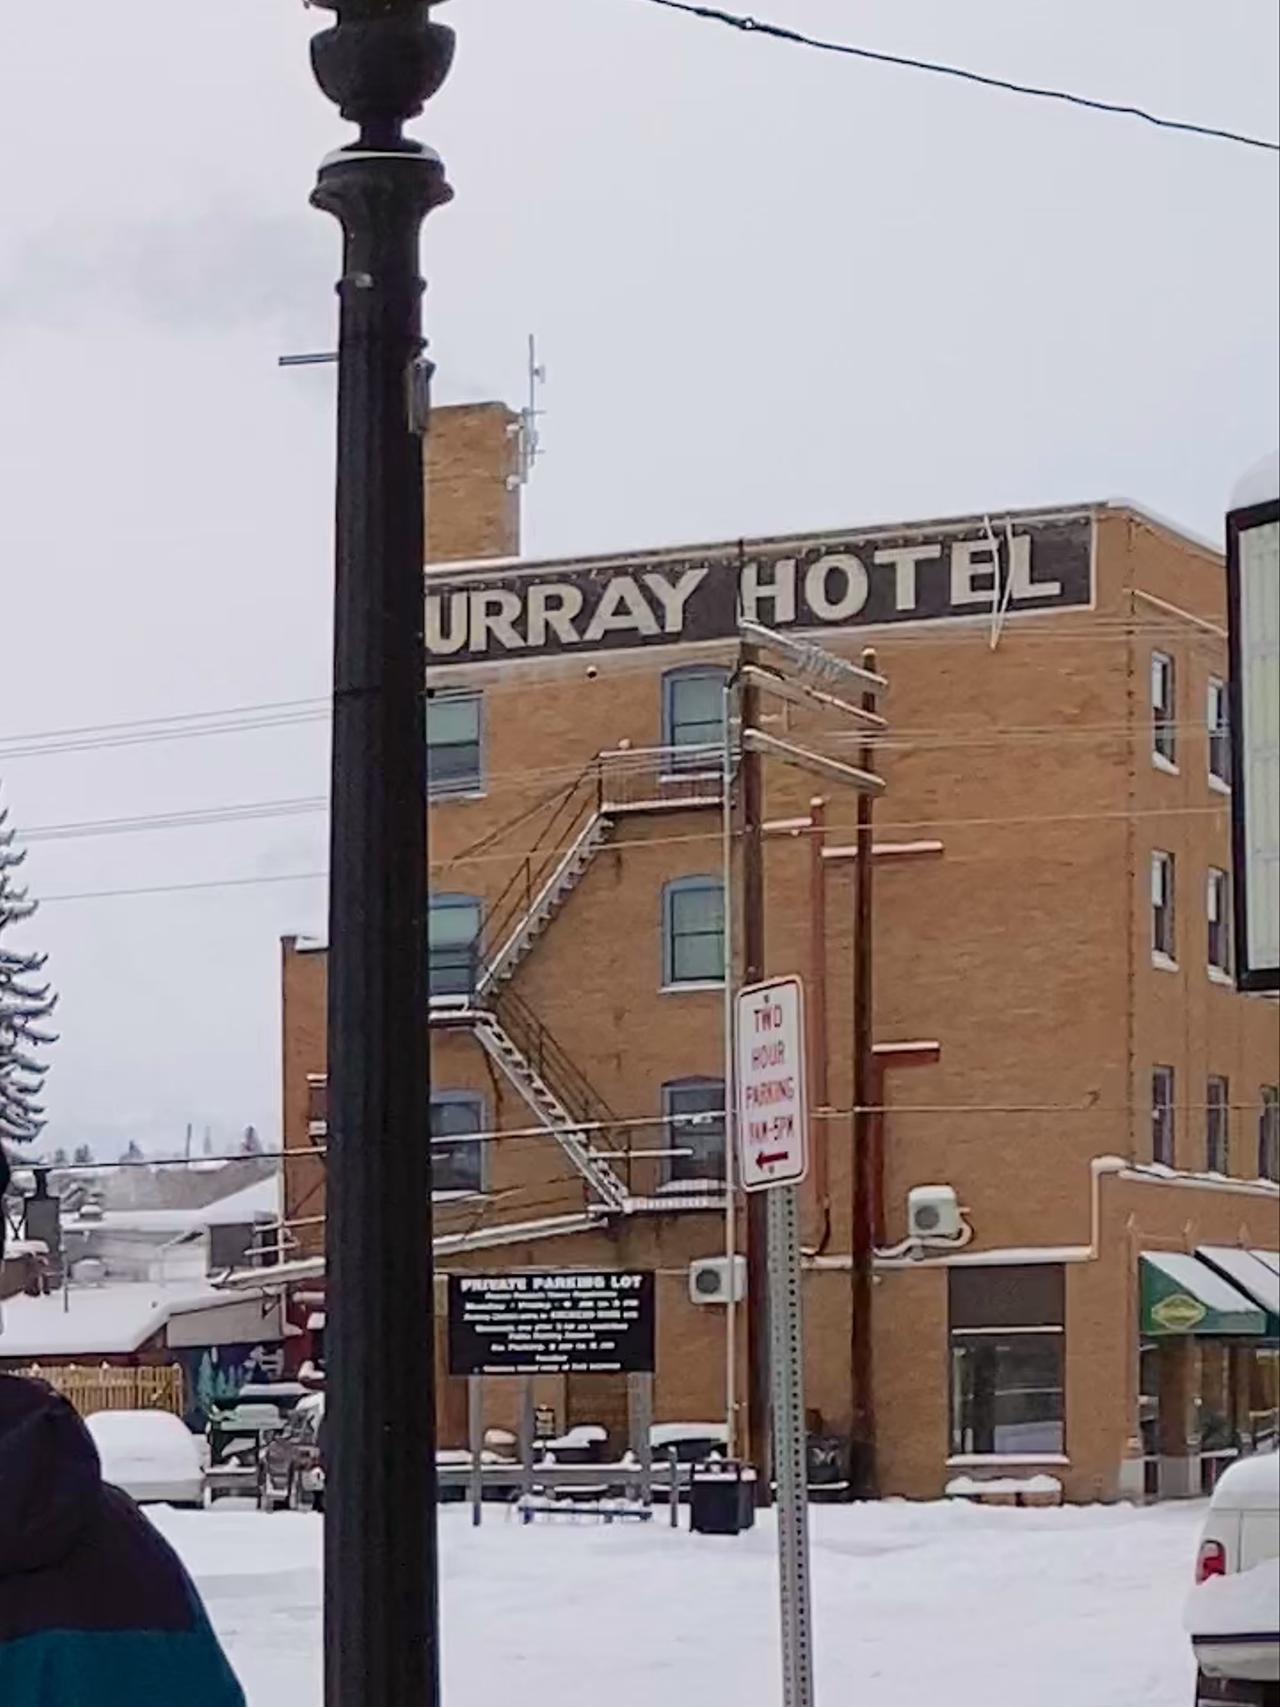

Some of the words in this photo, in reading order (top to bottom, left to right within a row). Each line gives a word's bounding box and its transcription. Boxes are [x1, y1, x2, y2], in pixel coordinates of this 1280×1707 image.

[424, 567, 709, 656] URRAY
[739, 534, 1062, 625] HOTEL
[753, 1003, 783, 1034] TWO
[751, 1039, 786, 1071] HOUR
[745, 1076, 795, 1110] PARKING
[460, 1277, 527, 1292] PRIVATE
[532, 1275, 606, 1291] PARKING
[610, 1275, 643, 1289] LOT
